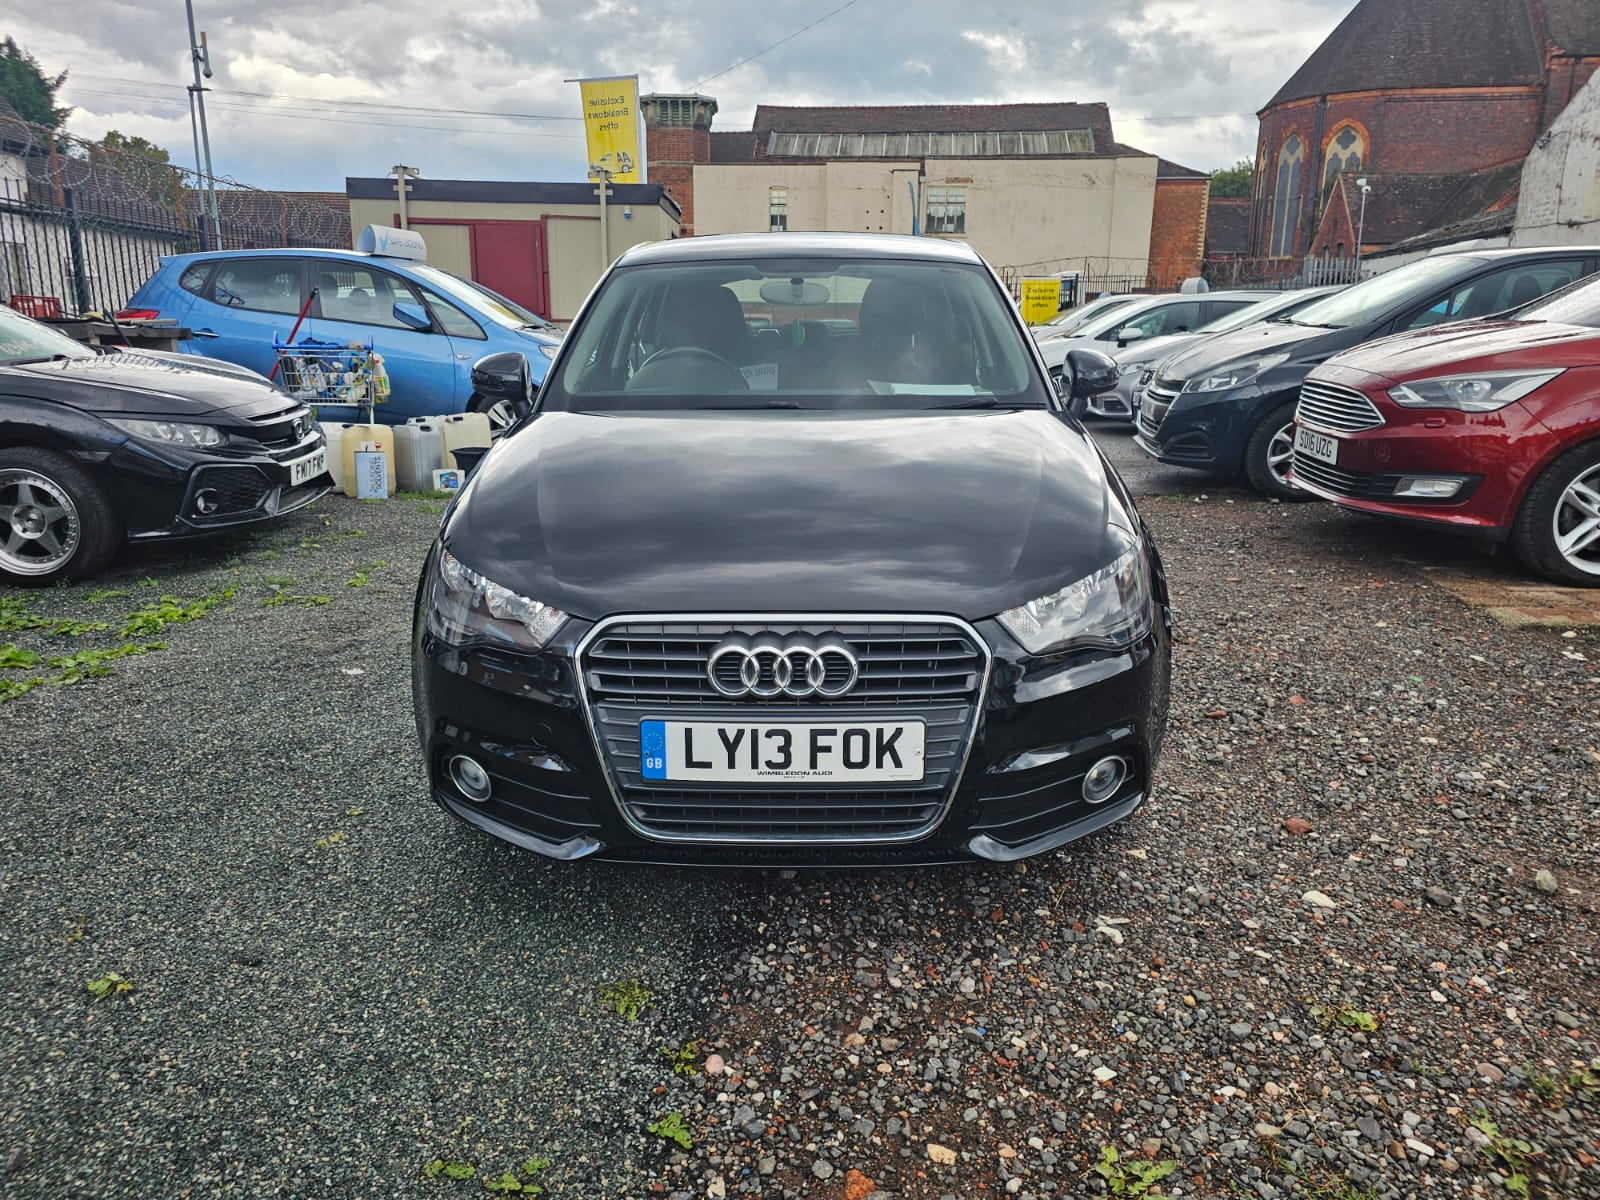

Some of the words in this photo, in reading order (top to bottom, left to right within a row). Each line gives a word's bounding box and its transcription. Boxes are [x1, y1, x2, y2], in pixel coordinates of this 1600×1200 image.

[1316, 436, 1332, 458] UZG
[684, 728, 792, 770] LY13
[809, 728, 904, 769] FOK
[646, 757, 663, 769] GB
